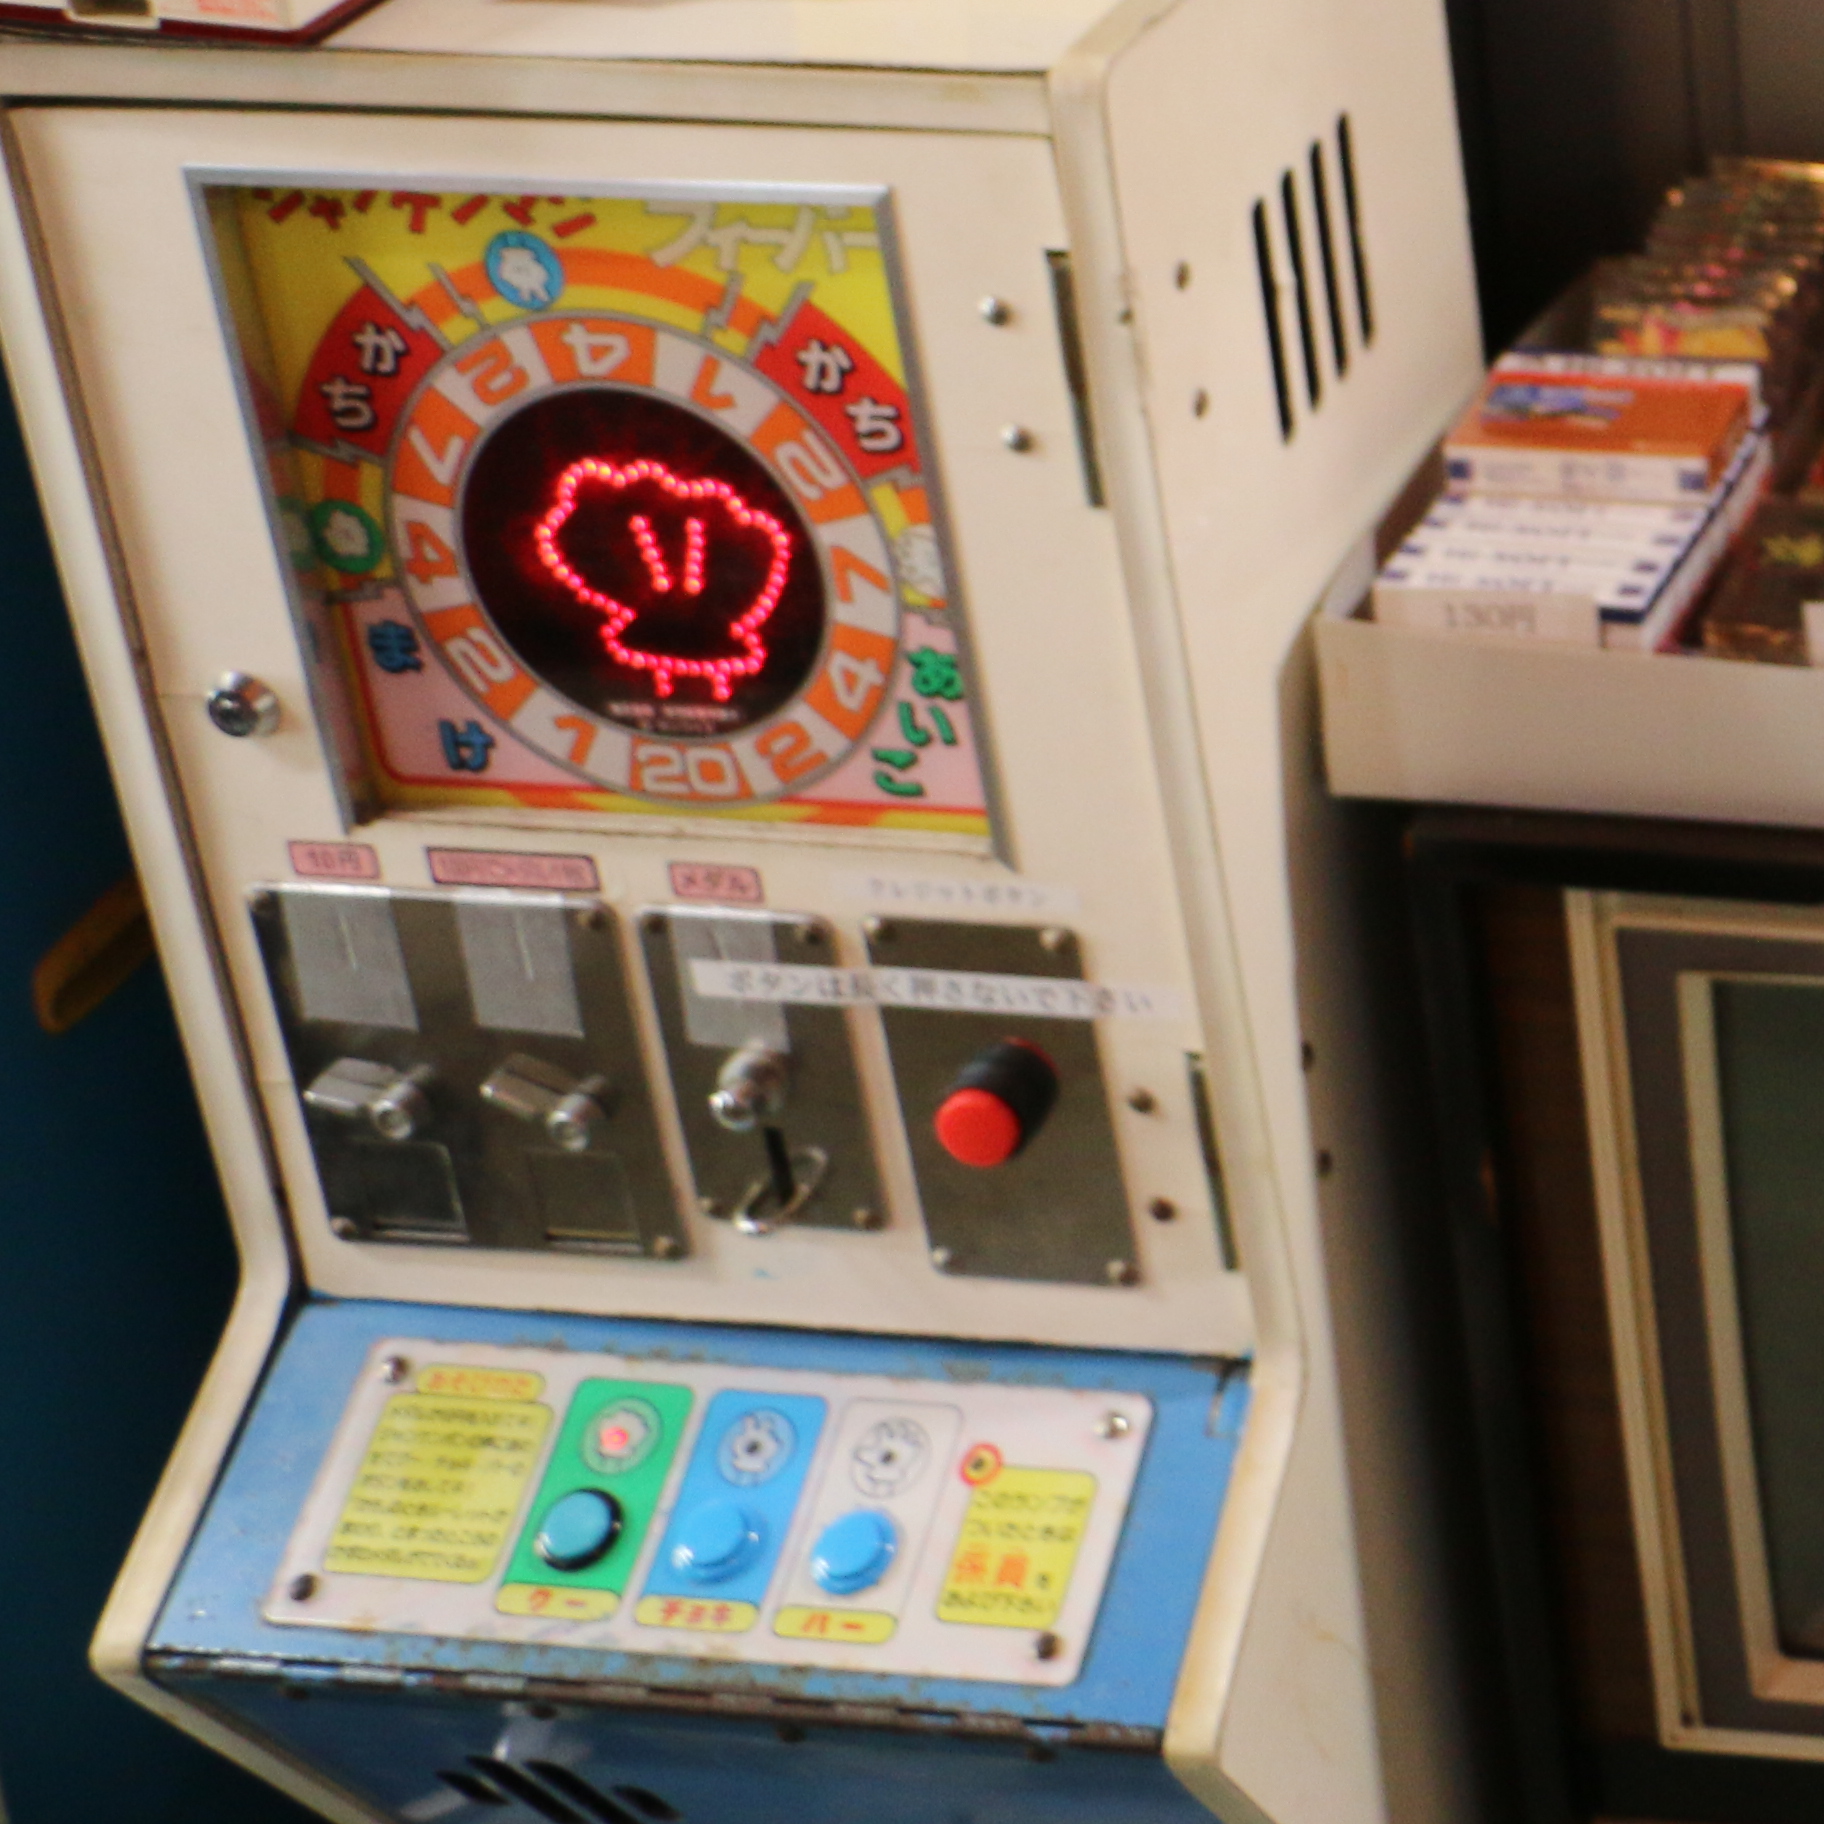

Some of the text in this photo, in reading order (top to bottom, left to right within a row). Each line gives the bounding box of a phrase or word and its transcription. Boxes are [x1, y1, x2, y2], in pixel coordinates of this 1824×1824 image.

[321, 320, 410, 432] かち
[564, 321, 636, 368] 4
[796, 340, 905, 456] かち
[639, 744, 741, 796] 20
[871, 644, 967, 798] あいこ
